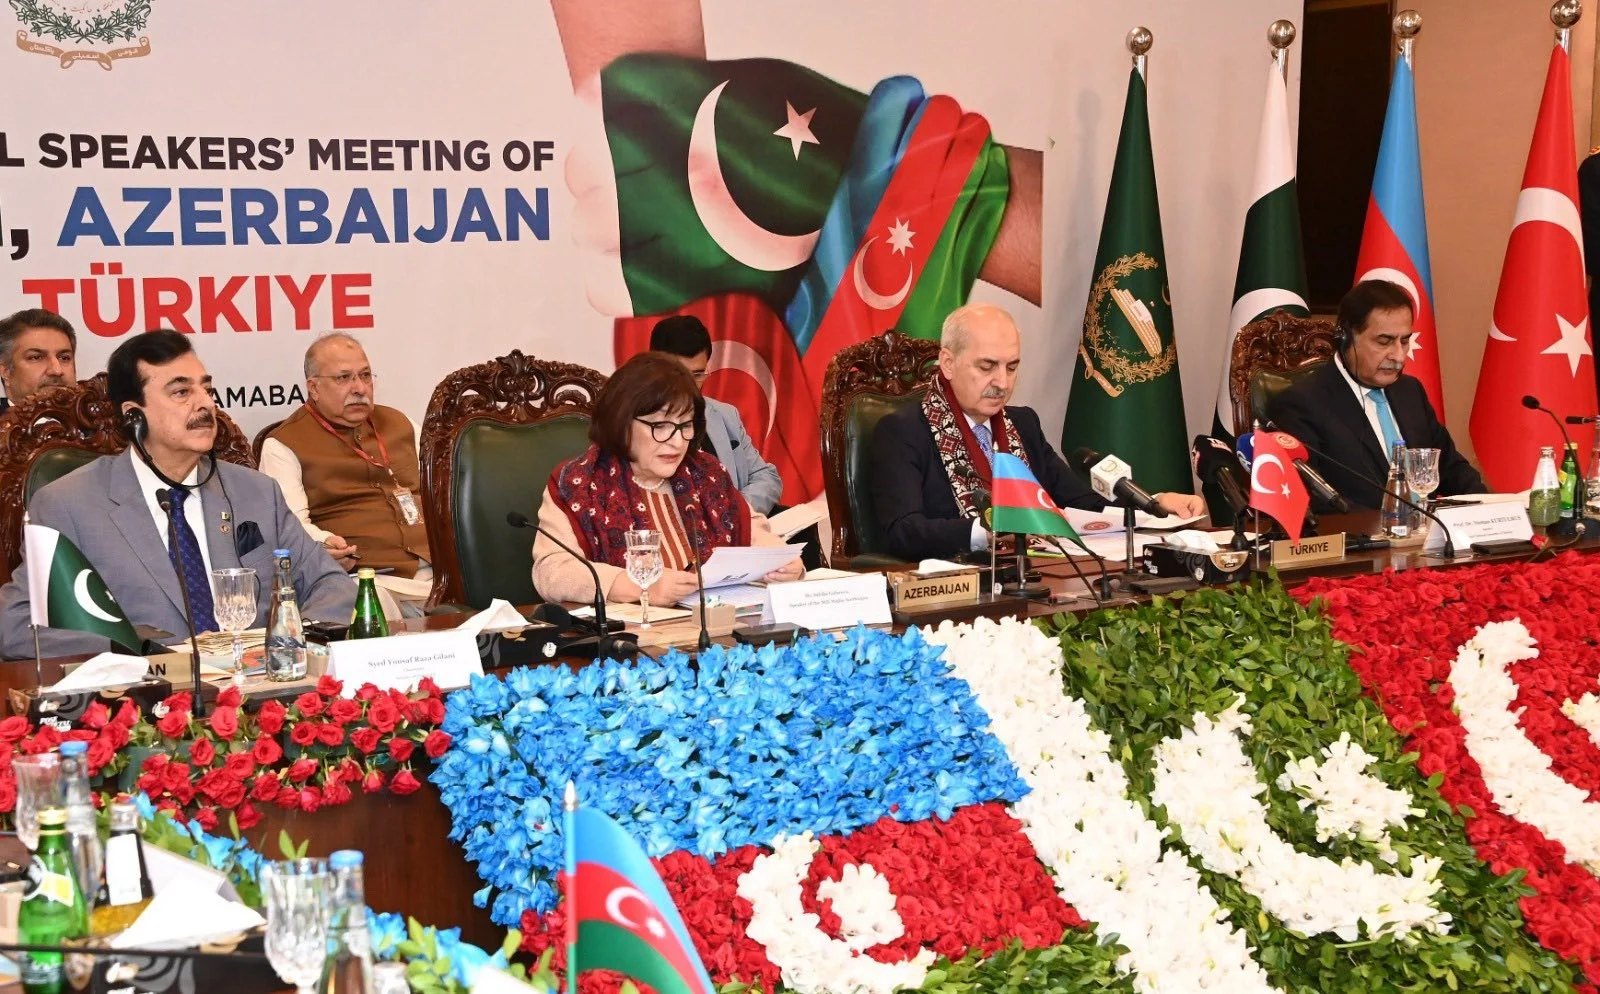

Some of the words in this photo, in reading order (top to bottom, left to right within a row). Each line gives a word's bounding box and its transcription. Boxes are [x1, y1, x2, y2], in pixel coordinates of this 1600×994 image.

[308, 138, 491, 171] MEETING
[502, 140, 555, 171] OF
[57, 186, 550, 247] AZERBAIJAN
[22, 262, 374, 338] TÜRKIYE
[904, 583, 970, 599] AZERBAIJAN
[368, 658, 386, 669] Syed
[387, 656, 413, 667] Yousaf
[414, 655, 432, 664] Raza
